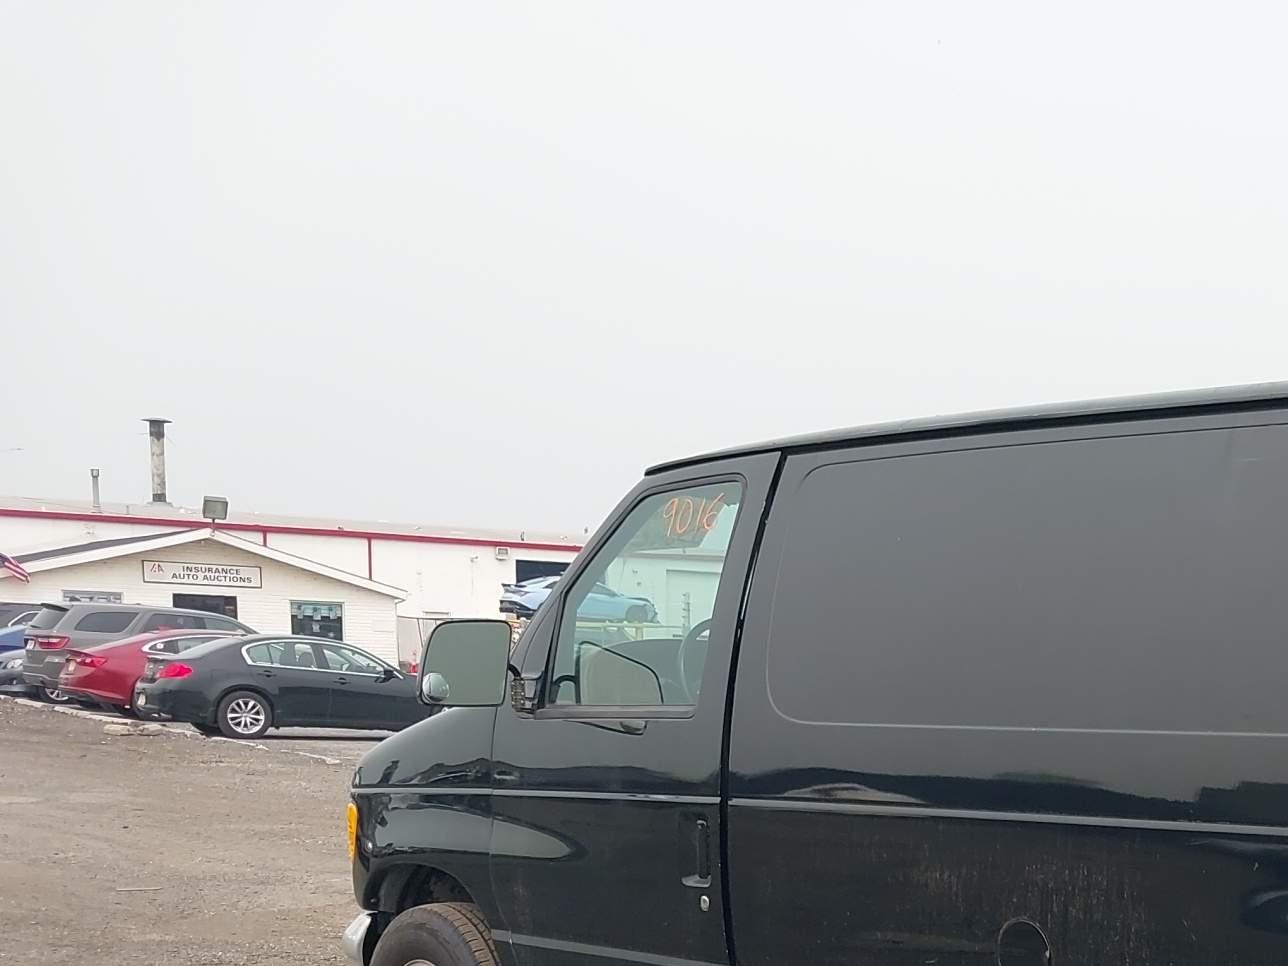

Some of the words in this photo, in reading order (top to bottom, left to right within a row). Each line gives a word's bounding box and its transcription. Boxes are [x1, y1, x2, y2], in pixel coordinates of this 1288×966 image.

[663, 492, 725, 537] 9016
[182, 565, 241, 576] INSURANCE
[171, 572, 199, 581] AUTO
[202, 573, 253, 583] AUCTIONS
